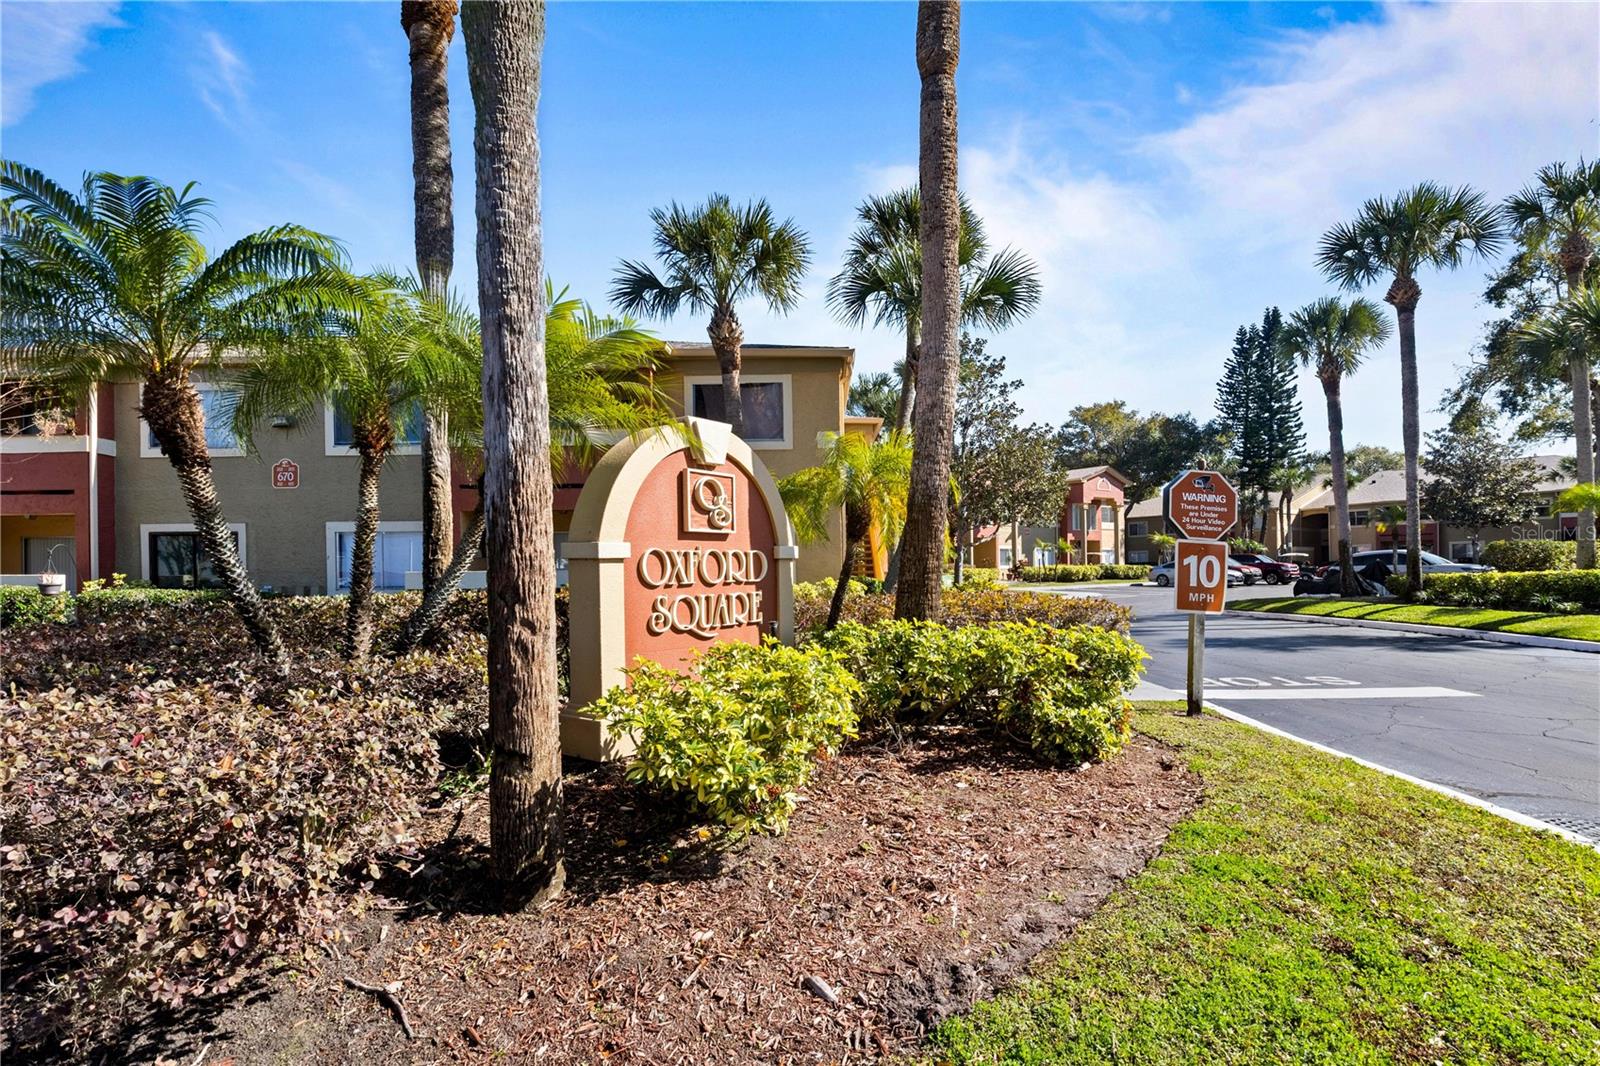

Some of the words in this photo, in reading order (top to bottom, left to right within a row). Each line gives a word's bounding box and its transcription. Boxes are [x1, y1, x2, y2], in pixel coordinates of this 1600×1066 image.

[277, 471, 294, 482] 670
[1182, 492, 1227, 503] WARNING
[1200, 504, 1228, 512] Premises
[1186, 523, 1222, 532] Surveillance
[638, 546, 768, 587] OXFORD
[1183, 554, 1221, 588] 10
[1188, 592, 1215, 603] MPH
[649, 590, 763, 638] SQUARE
